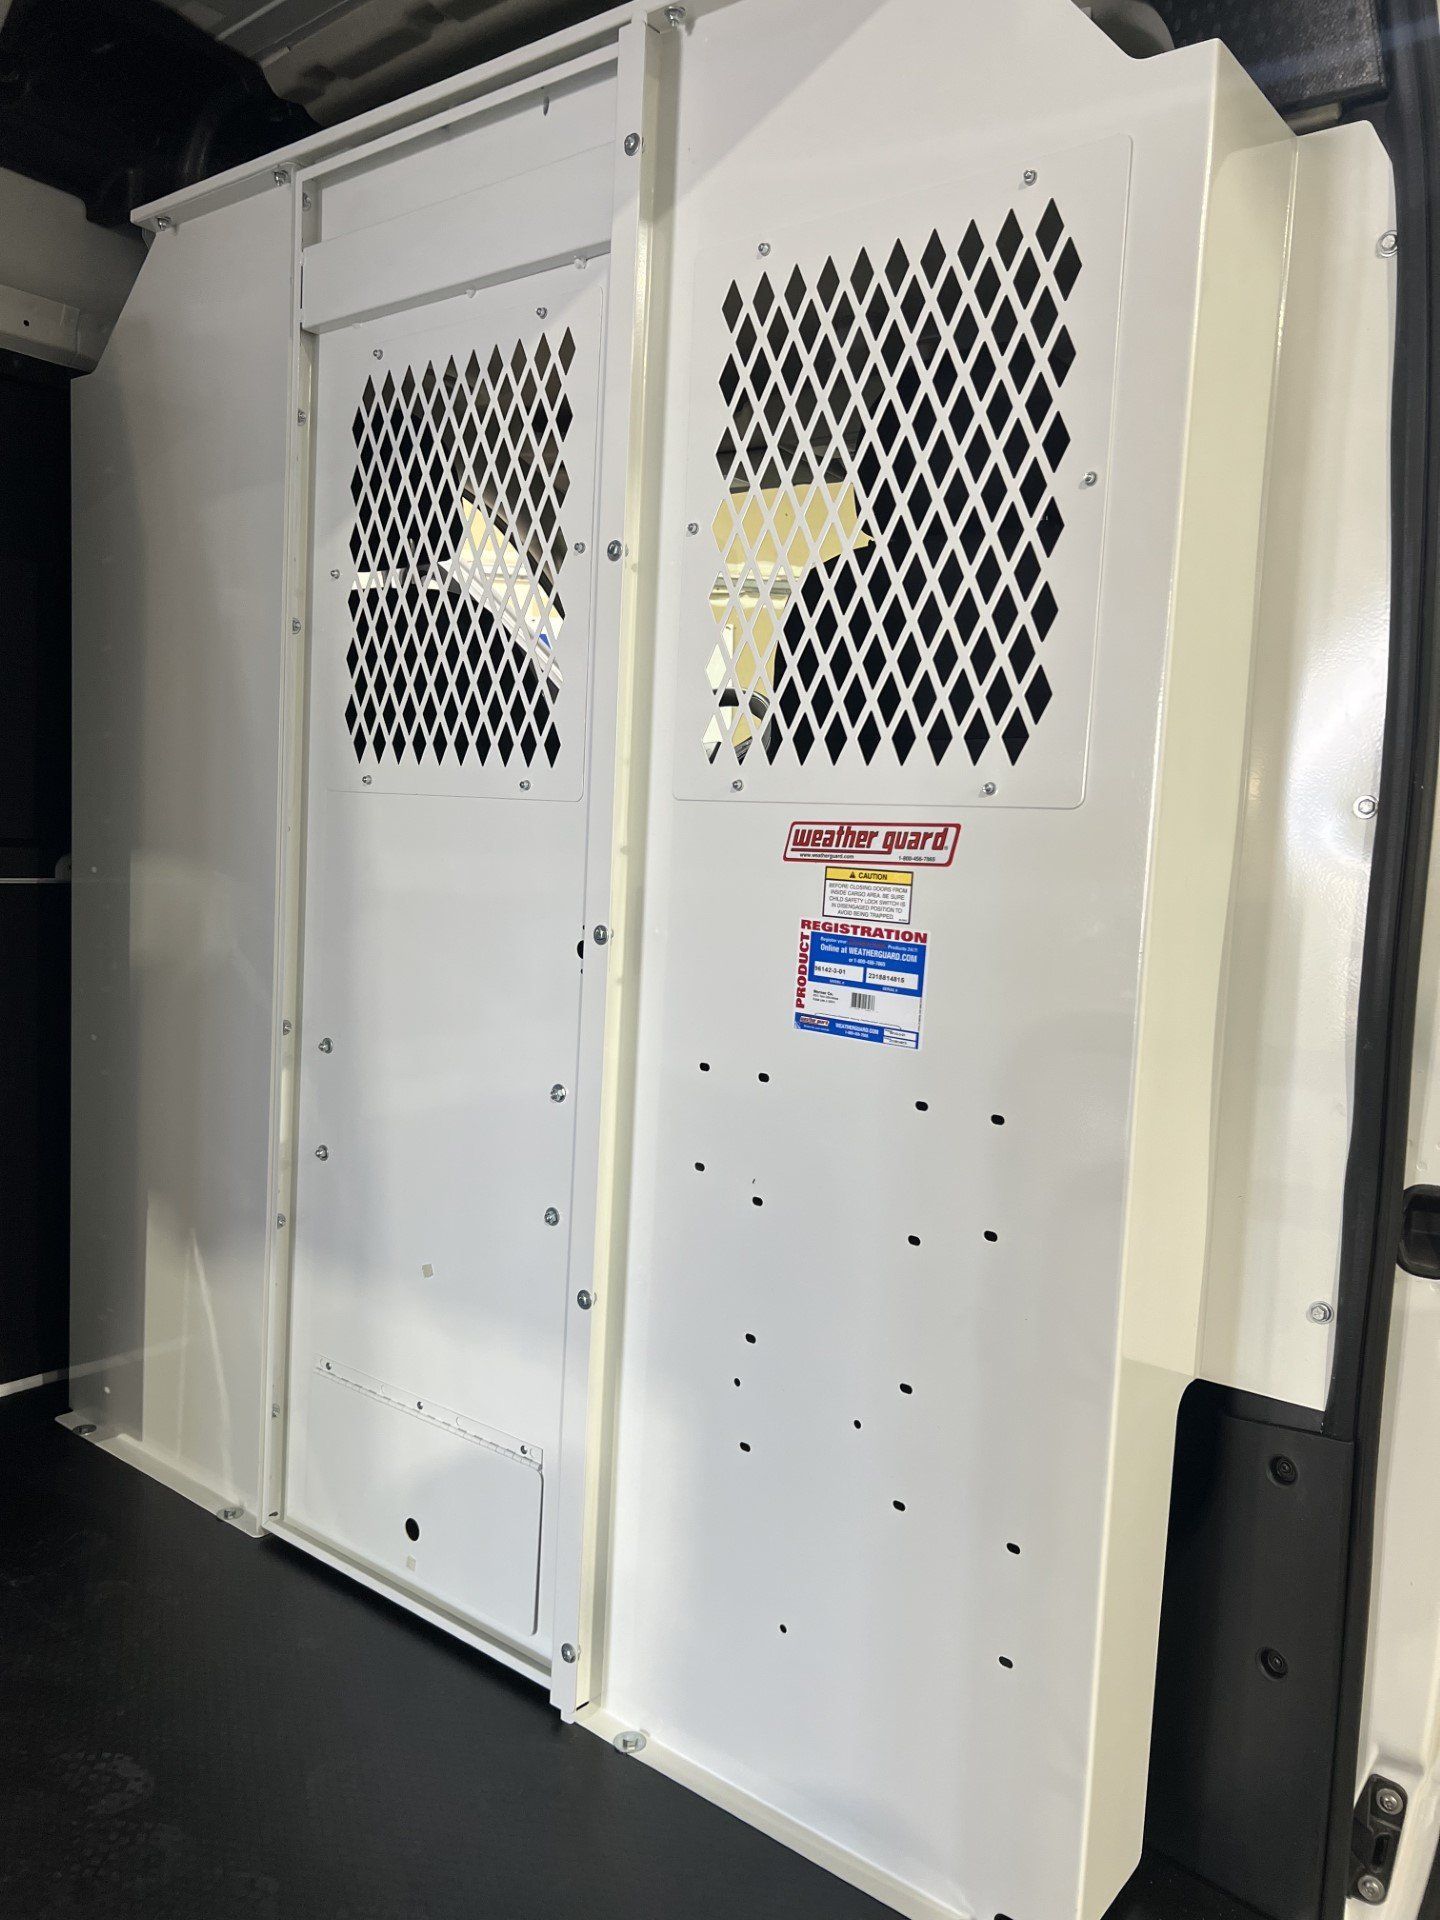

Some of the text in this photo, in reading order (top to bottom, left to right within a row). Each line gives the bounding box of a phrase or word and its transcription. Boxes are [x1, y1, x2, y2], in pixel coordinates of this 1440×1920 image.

[793, 826, 949, 854] weather guard
[799, 852, 854, 860] www.weatherguard.com
[858, 872, 888, 880] CAUTION
[837, 903, 870, 911] DISENGAGED
[870, 905, 895, 913] POSITION
[801, 919, 928, 944] REGISTRATION
[820, 943, 840, 953] Online
[848, 946, 918, 963] WEATHERGUARD.COM
[795, 931, 810, 1009] PRODUCT
